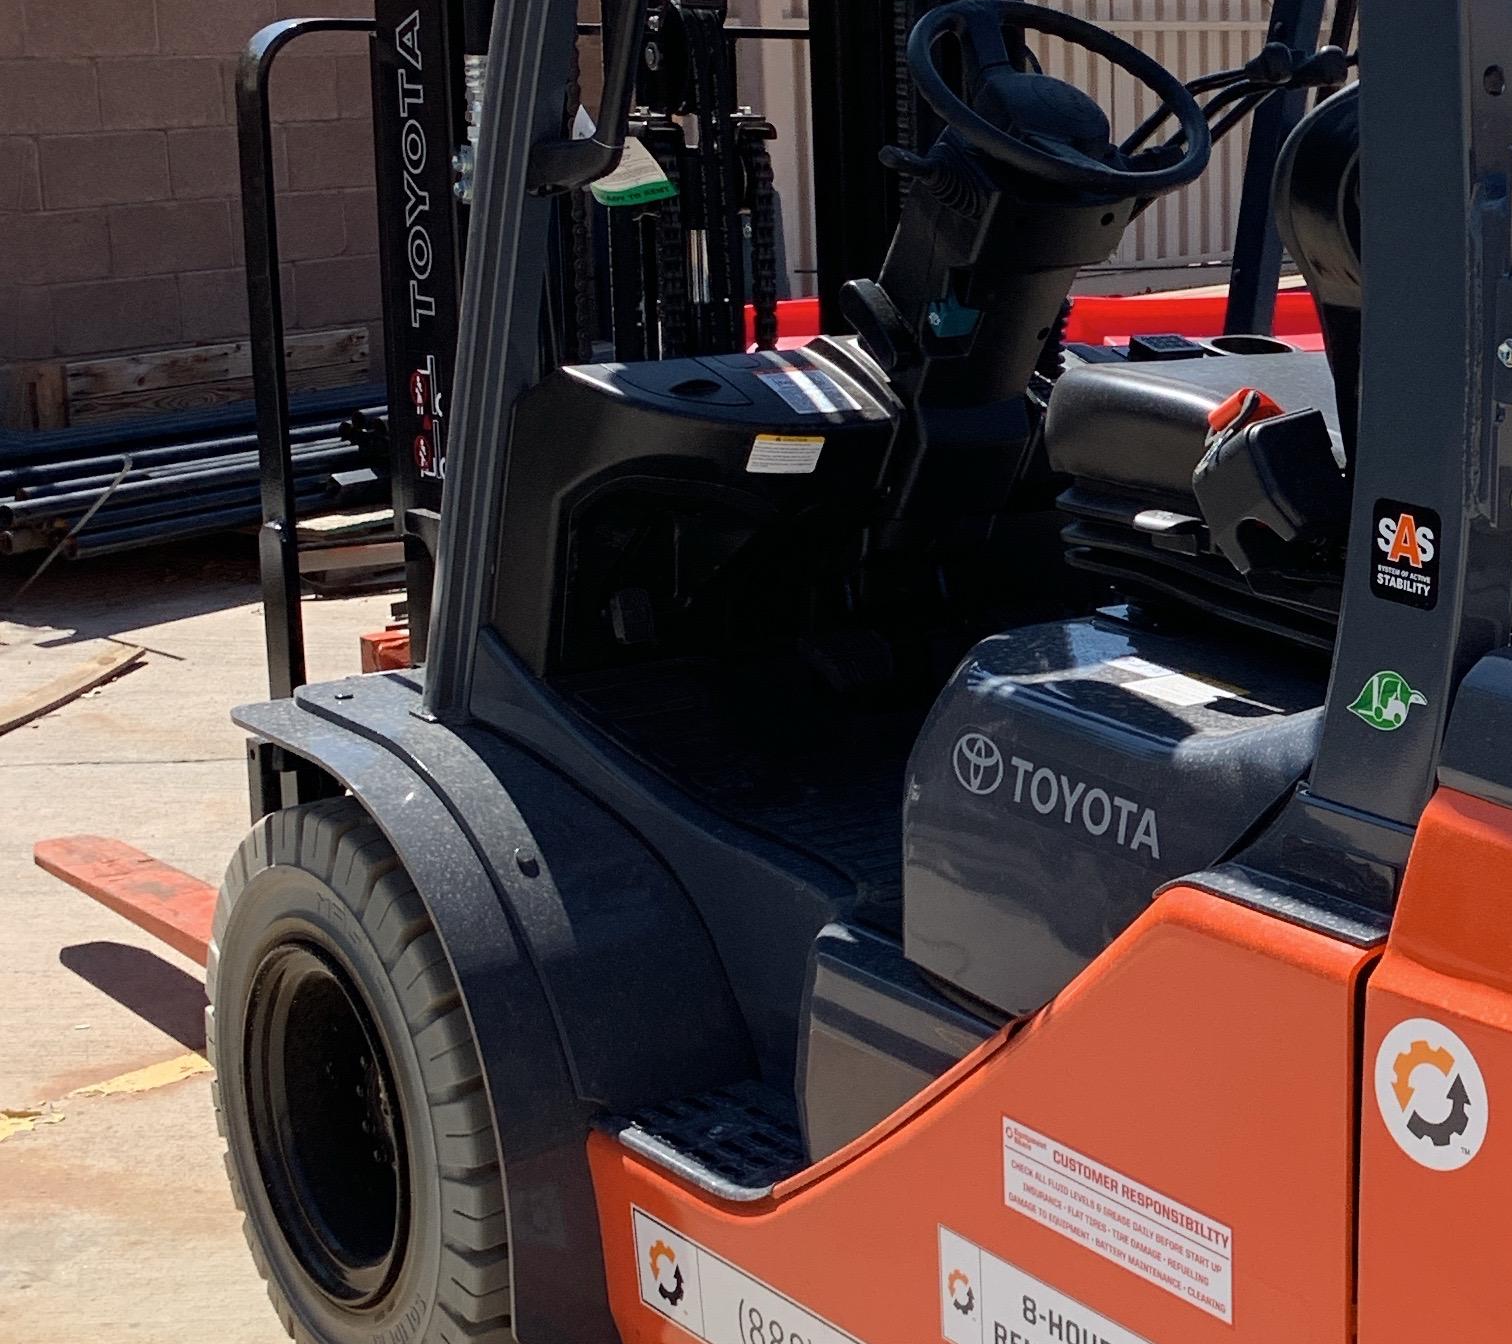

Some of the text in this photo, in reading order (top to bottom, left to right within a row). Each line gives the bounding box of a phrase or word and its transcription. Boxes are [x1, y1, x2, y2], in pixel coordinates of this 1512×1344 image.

[395, 9, 436, 329] TOYOTA
[1376, 572, 1431, 597] STABILITY
[1377, 513, 1435, 569] SAS
[1010, 755, 1161, 860] TOYOTA
[1011, 1159, 1034, 1179] CHECK
[1035, 1170, 1047, 1185] ALL
[1047, 1177, 1069, 1197] FLUID
[1069, 1187, 1095, 1209] LEVELS
[1103, 1204, 1132, 1228] GREASE
[1132, 1219, 1154, 1240] DAILY
[1155, 1230, 1184, 1255] BEFORE
[1185, 1244, 1210, 1269] START
[1210, 1259, 1223, 1274] UP
[1022, 1181, 1210, 1287] INSURANCE FLAT TIRES TIRE DAMAGE REFUELING
[1052, 1149, 1230, 1249] CUSTOMER RESPONSIBILITY
[1008, 1191, 1227, 1314] DAMAGE TO EQUIPMENT BATTERY MAINTENANCE CLEANING
